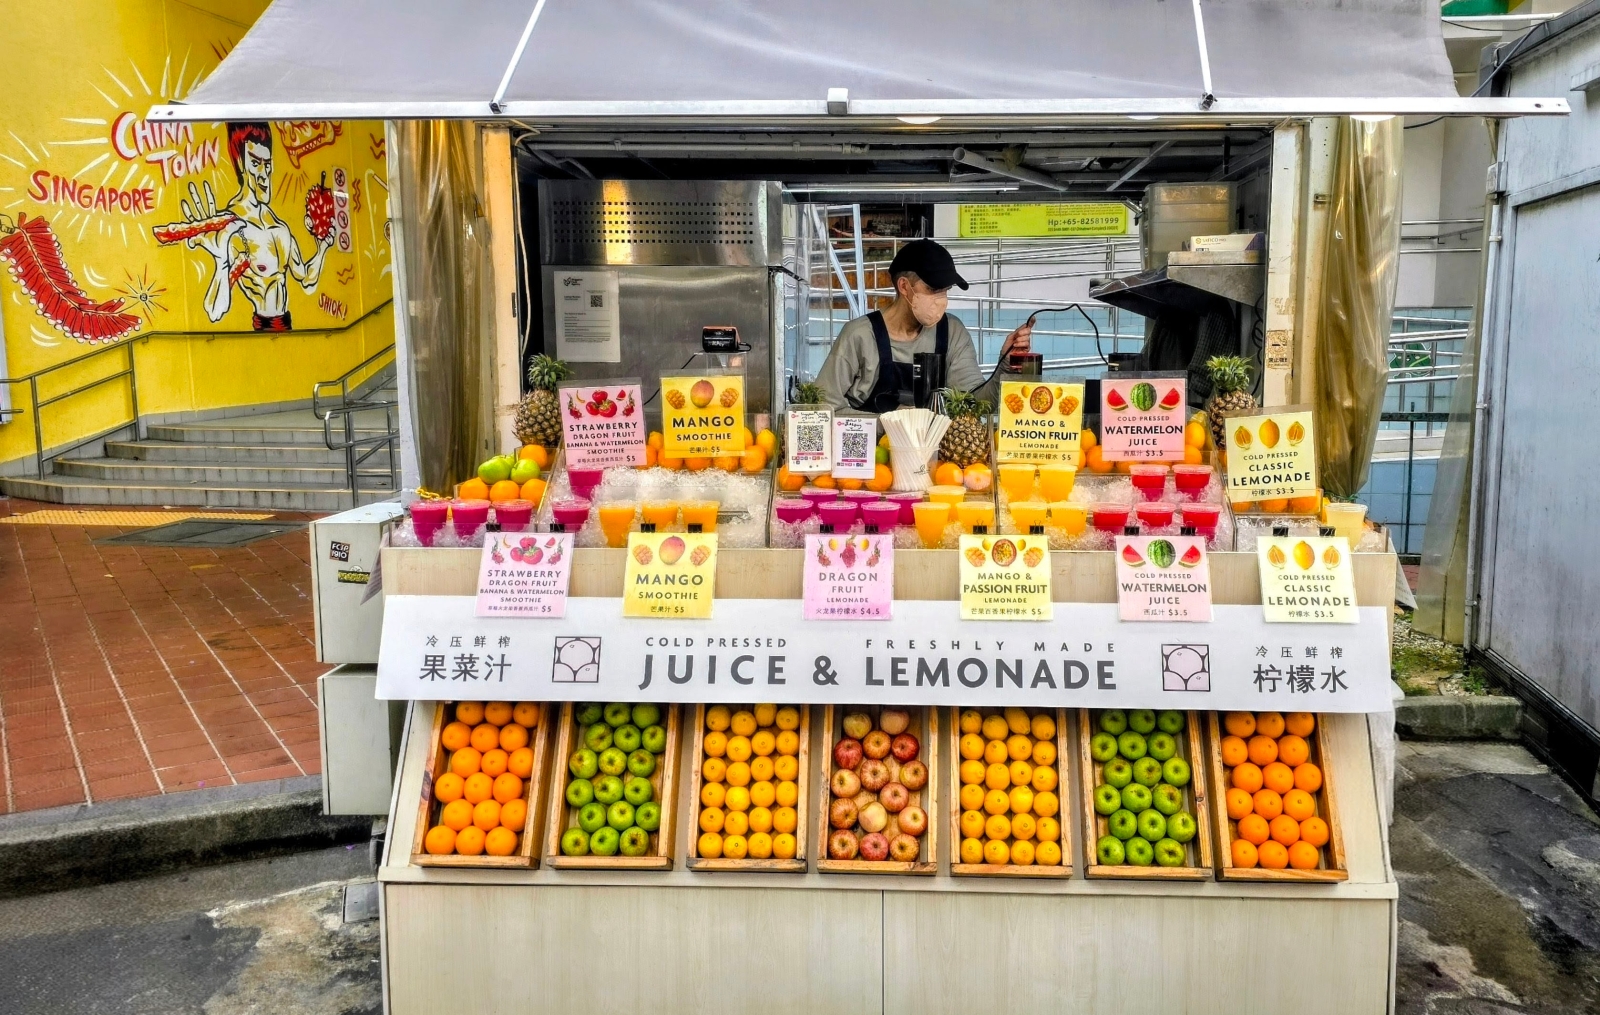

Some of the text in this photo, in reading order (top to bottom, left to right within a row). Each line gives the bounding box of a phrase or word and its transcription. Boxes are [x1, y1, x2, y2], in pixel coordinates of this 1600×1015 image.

[111, 111, 194, 160] CHINA
[146, 137, 219, 186] TOWN
[28, 170, 155, 217] SINGAPORE
[318, 292, 348, 320] SHIOK!
[570, 422, 637, 431] STRAWBERRY
[673, 416, 734, 427] MANGO
[1001, 430, 1078, 440] PASSION FRUIT
[1105, 426, 1183, 434] WATERMELON
[1249, 462, 1293, 471] CLASSIC
[1233, 472, 1310, 486] LEMONADE
[636, 574, 703, 585] MANGO
[819, 573, 878, 581] DRAGON
[964, 585, 1047, 593] PASSION FRUIT
[1122, 583, 1206, 592] WATERMELON
[1149, 597, 1180, 605] JUICE
[1269, 597, 1350, 606] LEMONADE
[426, 635, 510, 648] 冷压鲜榨
[646, 637, 787, 648] COLD PRESSED
[866, 639, 1114, 652] FRESHLY MADE
[1256, 645, 1343, 659] 冷压鲜榨
[420, 654, 512, 682] 果菜汁
[638, 654, 1117, 690] JUICE & LEMONADE
[1253, 664, 1349, 693] 柠檬水
